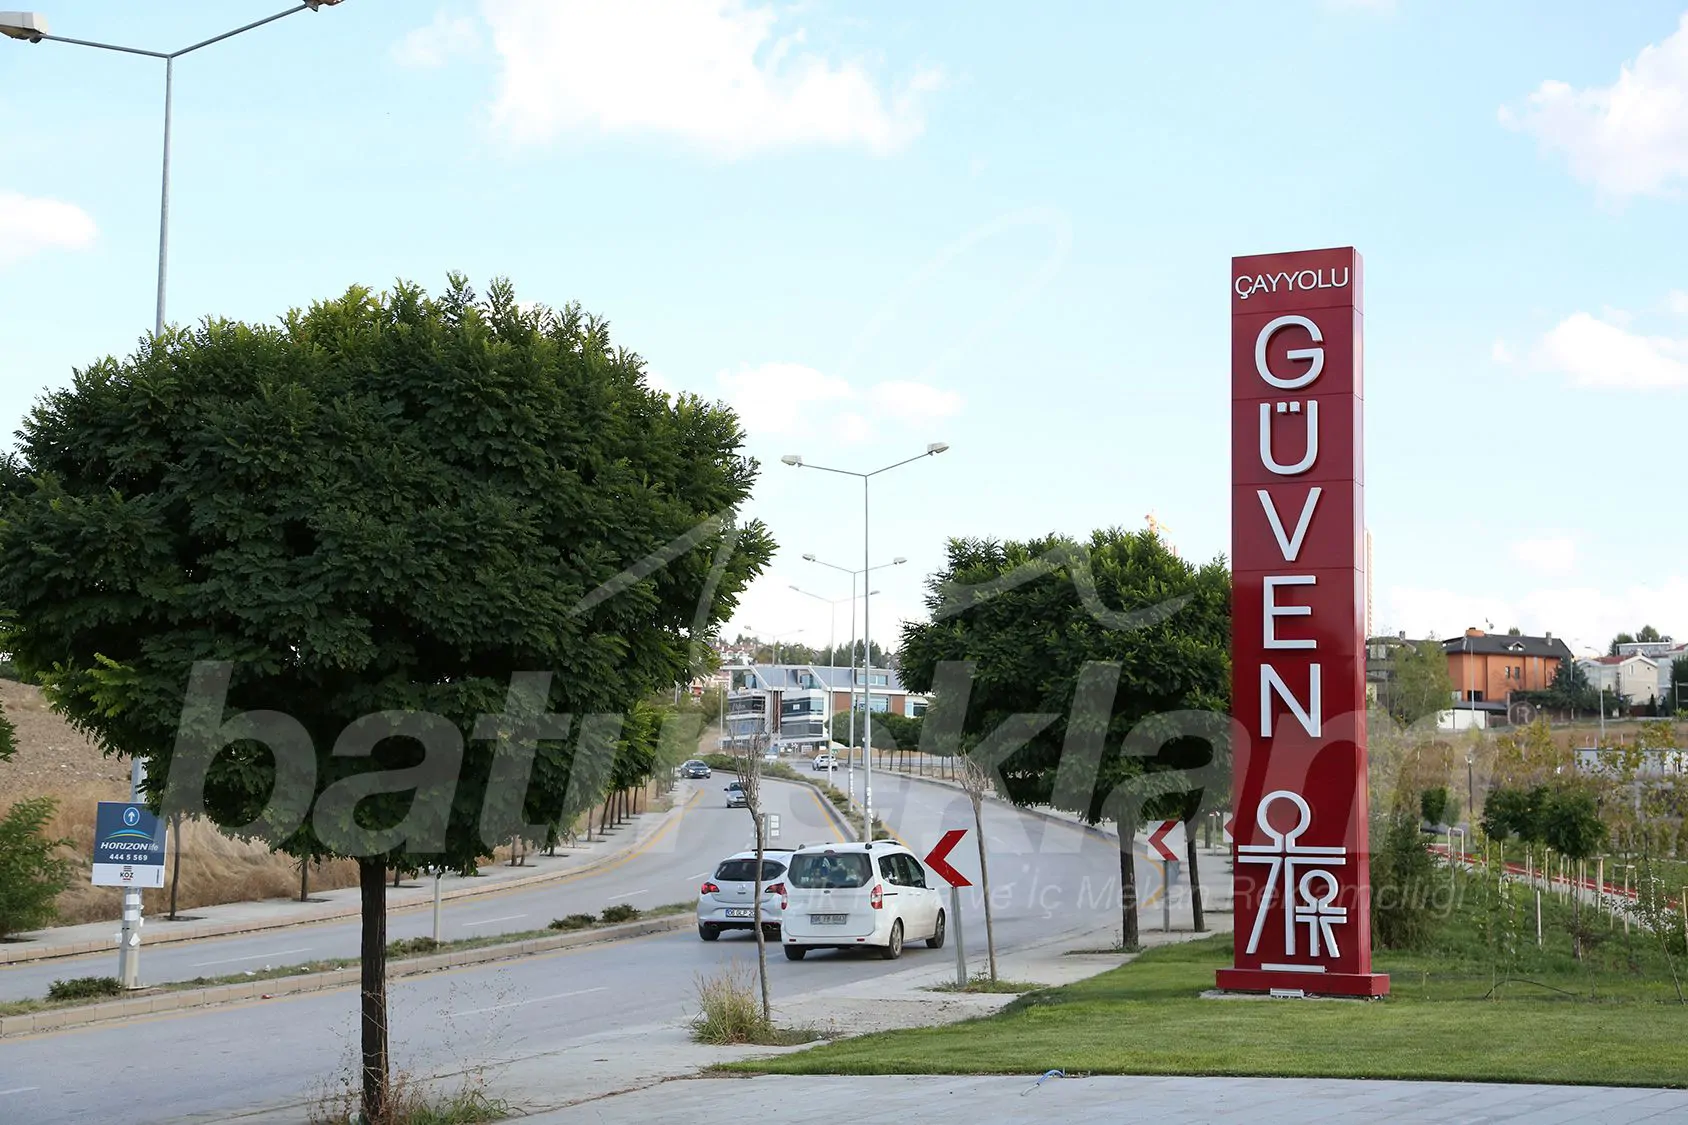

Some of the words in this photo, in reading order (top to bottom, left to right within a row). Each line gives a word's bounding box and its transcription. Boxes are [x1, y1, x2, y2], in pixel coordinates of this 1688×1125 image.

[1235, 266, 1350, 300] ÇAYYOLU
[1254, 314, 1326, 739] GÜVEN
[109, 853, 125, 861] 444
[126, 853, 132, 861] 5
[133, 854, 148, 862] 569
